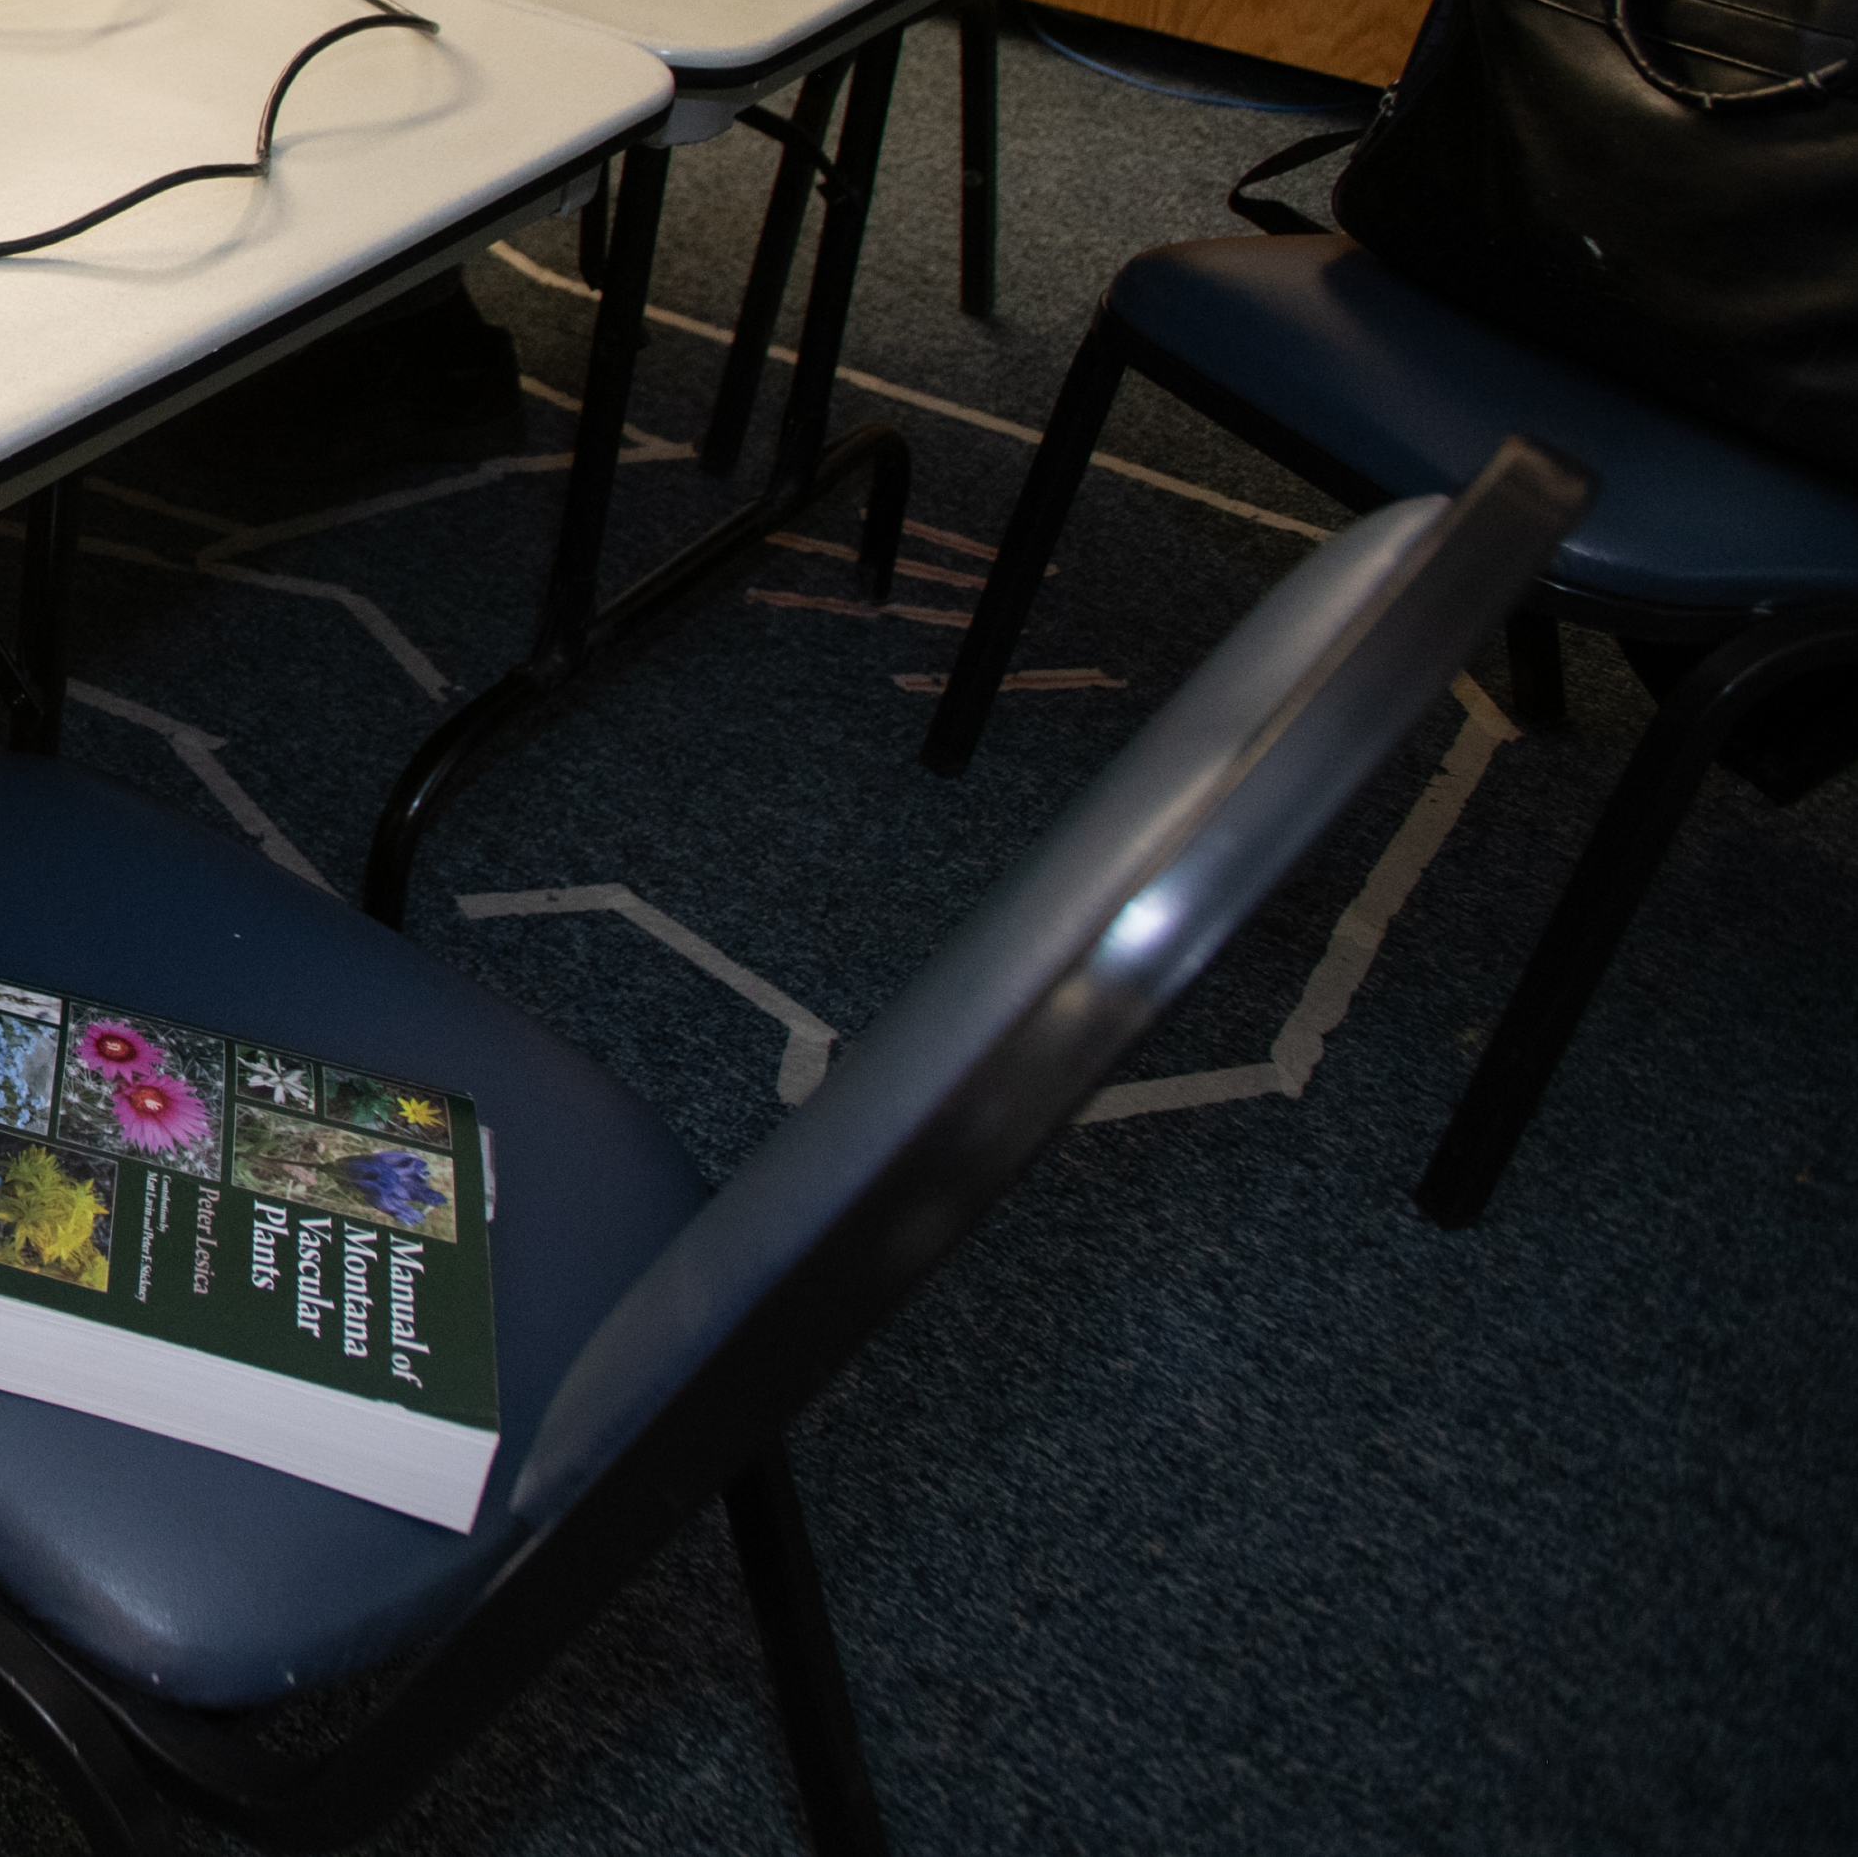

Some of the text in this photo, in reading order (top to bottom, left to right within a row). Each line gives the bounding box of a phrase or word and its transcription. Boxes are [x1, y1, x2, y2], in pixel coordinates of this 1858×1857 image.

[144, 1192, 157, 1216] Lavin
[146, 1170, 158, 1191] Matt
[158, 1175, 172, 1223] Contributions
[142, 1231, 154, 1254] Peter
[143, 1217, 154, 1231] and
[192, 1185, 221, 1296] Peter Lesica
[251, 1200, 288, 1293] Plants
[134, 1264, 152, 1303] Stickney
[297, 1215, 335, 1339] Vascular
[343, 1221, 379, 1359] Montana
[389, 1234, 433, 1390] Manual of
